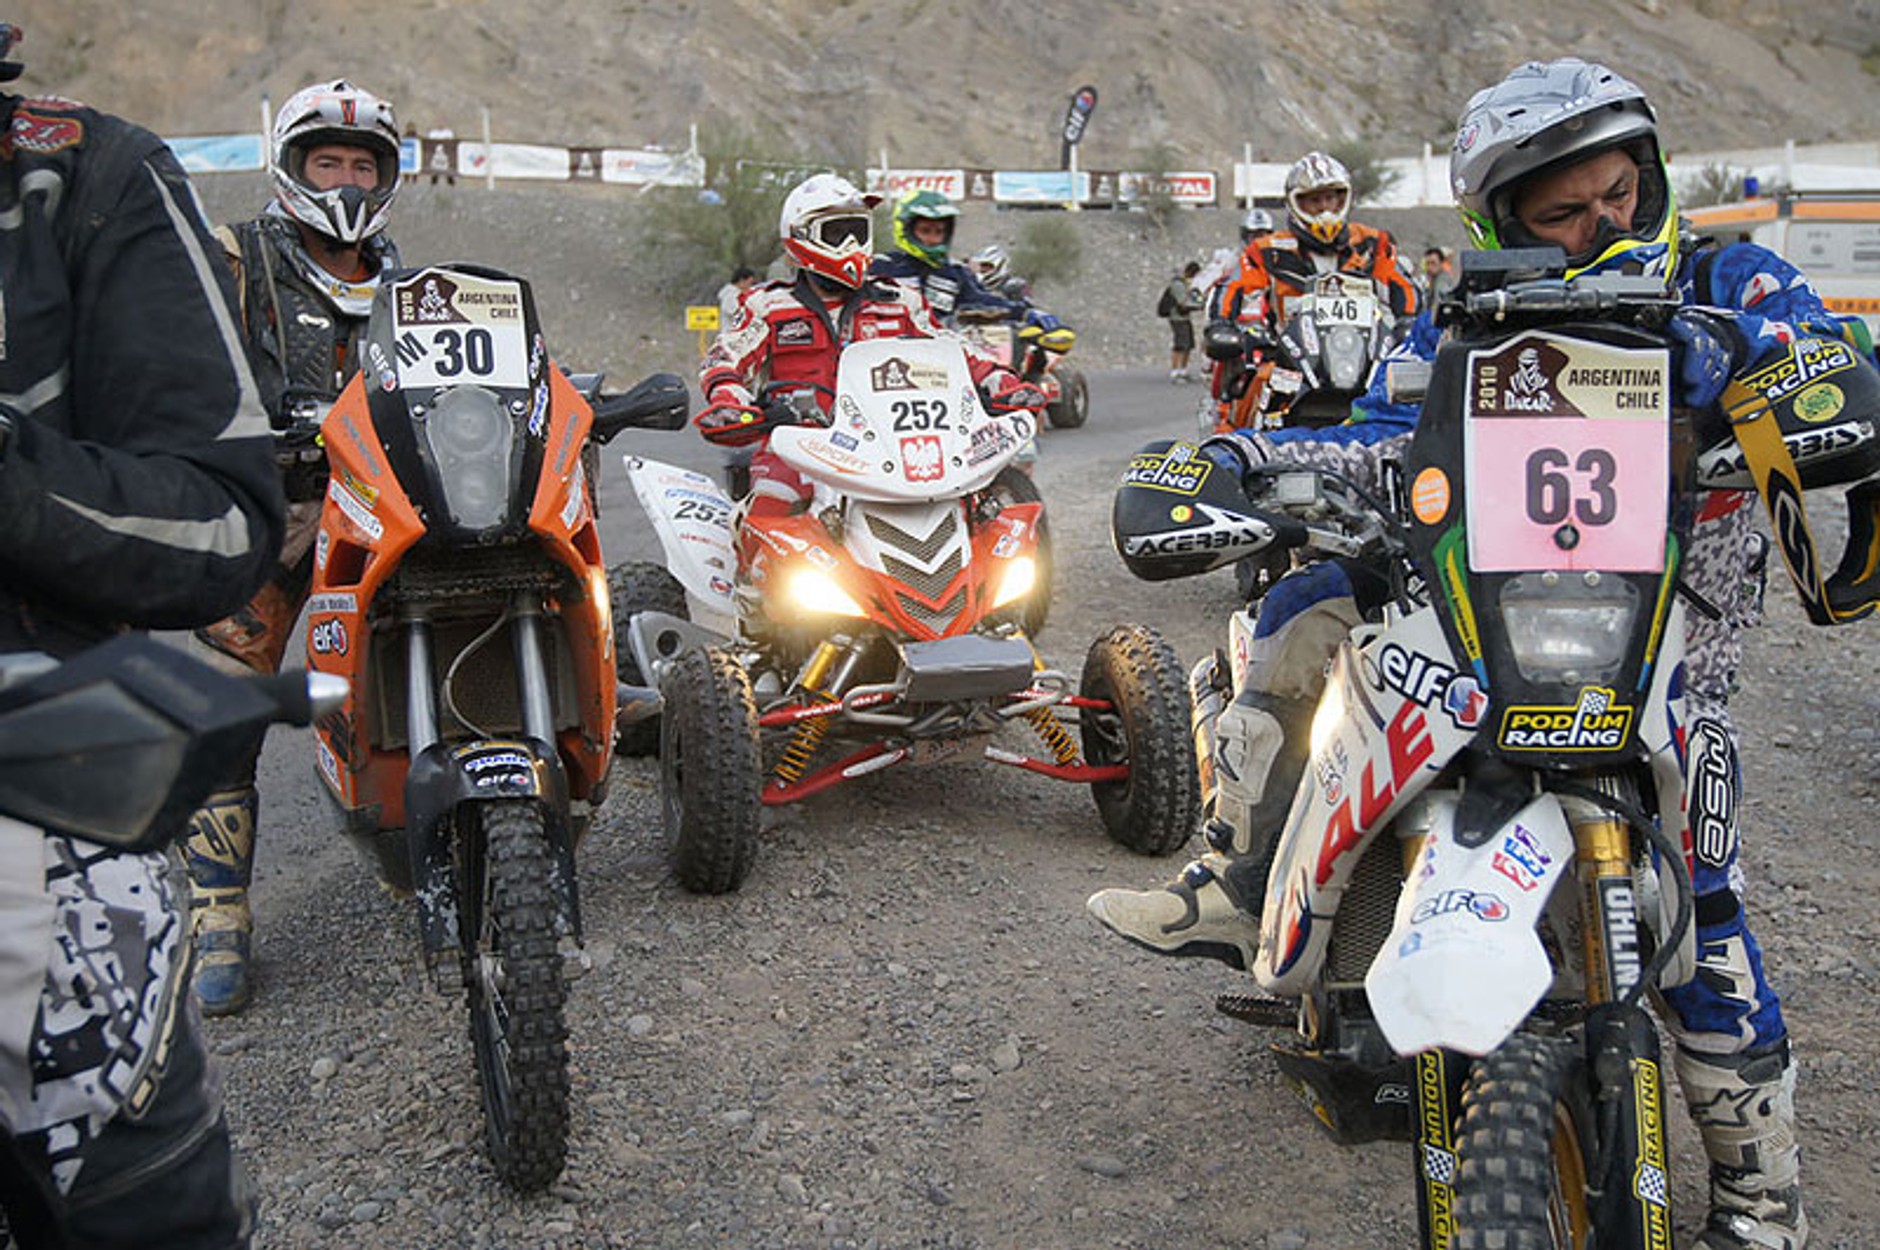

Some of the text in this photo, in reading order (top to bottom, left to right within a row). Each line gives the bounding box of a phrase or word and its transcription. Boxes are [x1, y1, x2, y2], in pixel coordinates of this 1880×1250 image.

[877, 175, 955, 192] LOCTITE
[457, 293, 518, 305] ARGENTINA
[490, 307, 518, 319] CHILE
[1331, 299, 1358, 321] 46
[394, 331, 429, 368] M
[432, 328, 495, 377] 30
[1479, 366, 1497, 410] 2010
[1567, 368, 1661, 387] ARGENTINA
[1766, 354, 1850, 398] ACING
[1504, 390, 1554, 412] DAKAR
[1616, 392, 1659, 409] CHILE
[890, 400, 951, 433] 252
[1525, 447, 1617, 527] 63
[1136, 528, 1260, 556] ACERBIS
[1380, 644, 1452, 707] elf
[1510, 712, 1626, 730] PODIUM
[1504, 730, 1621, 746] RACING
[1316, 697, 1435, 887] ALE
[1422, 1053, 1445, 1148] PODIUM
[1639, 1066, 1662, 1166] RACING
